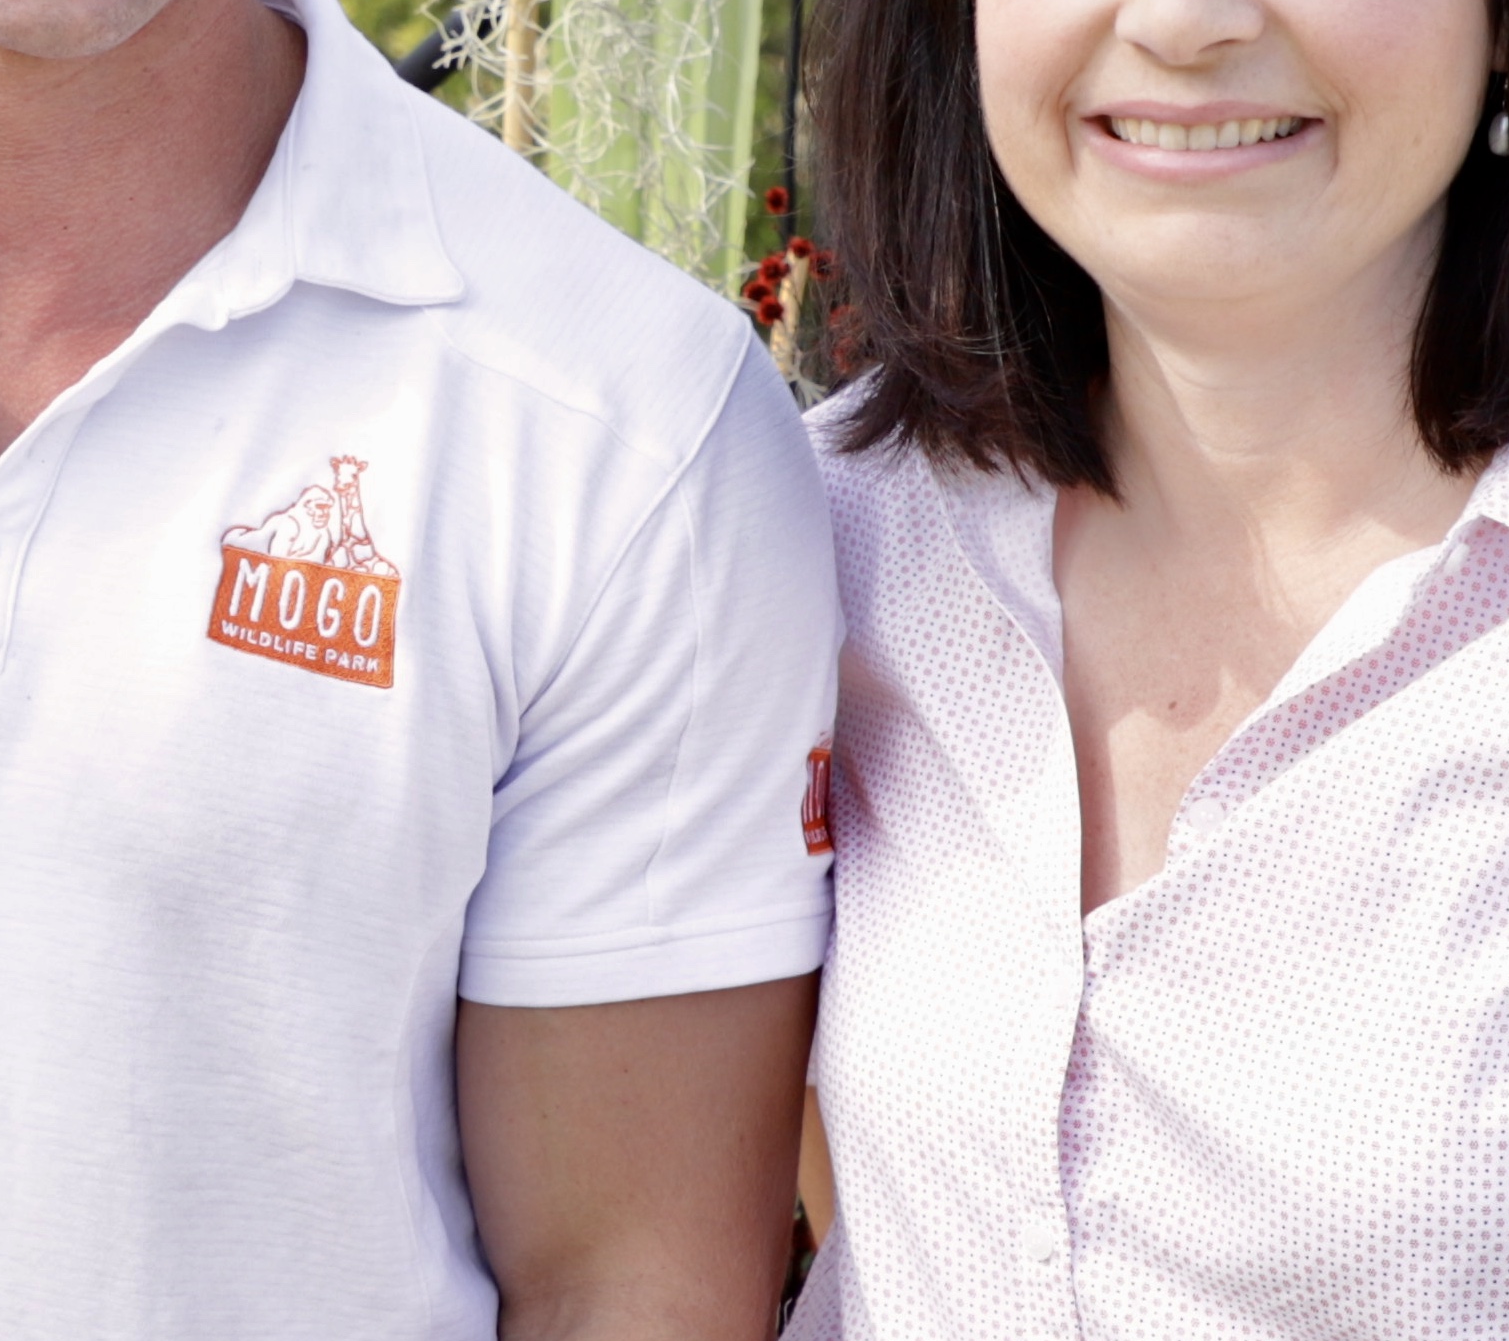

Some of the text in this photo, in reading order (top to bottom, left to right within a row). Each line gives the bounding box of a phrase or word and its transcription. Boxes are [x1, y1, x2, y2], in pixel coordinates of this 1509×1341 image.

[228, 557, 382, 648] MOGO
[221, 620, 380, 673] WILDLIFE PARK
